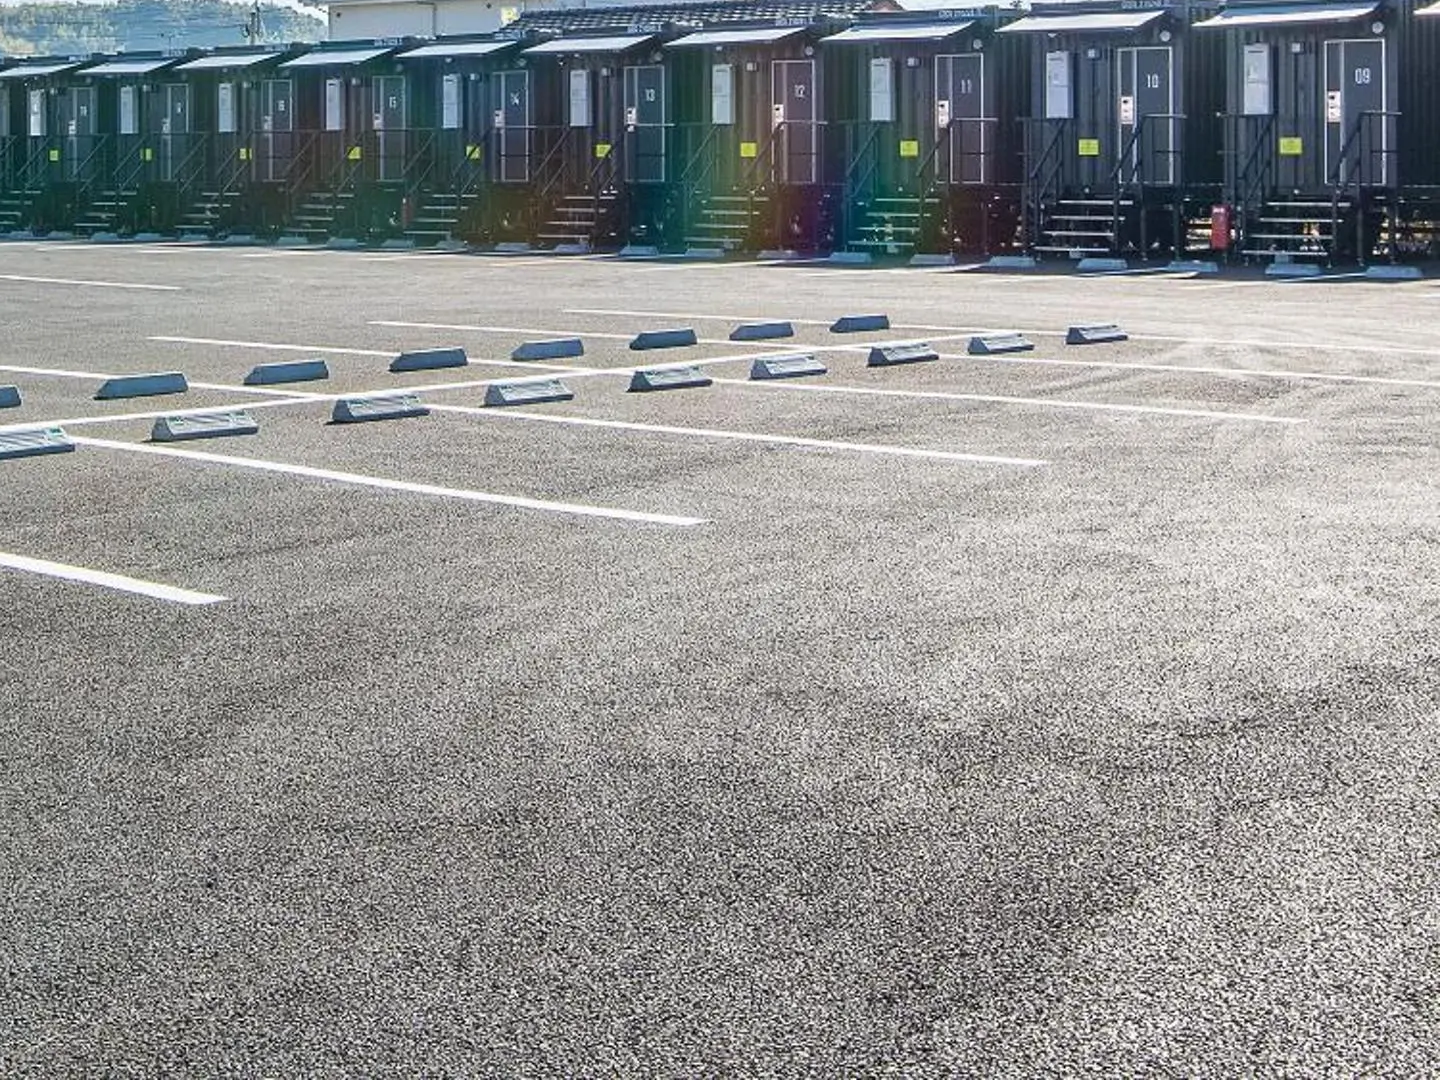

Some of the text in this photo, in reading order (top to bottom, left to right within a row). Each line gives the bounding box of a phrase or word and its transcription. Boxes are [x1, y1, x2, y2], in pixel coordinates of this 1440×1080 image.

[1147, 74, 1160, 89] 10
[1354, 67, 1371, 85] 09
[960, 79, 973, 94] 11
